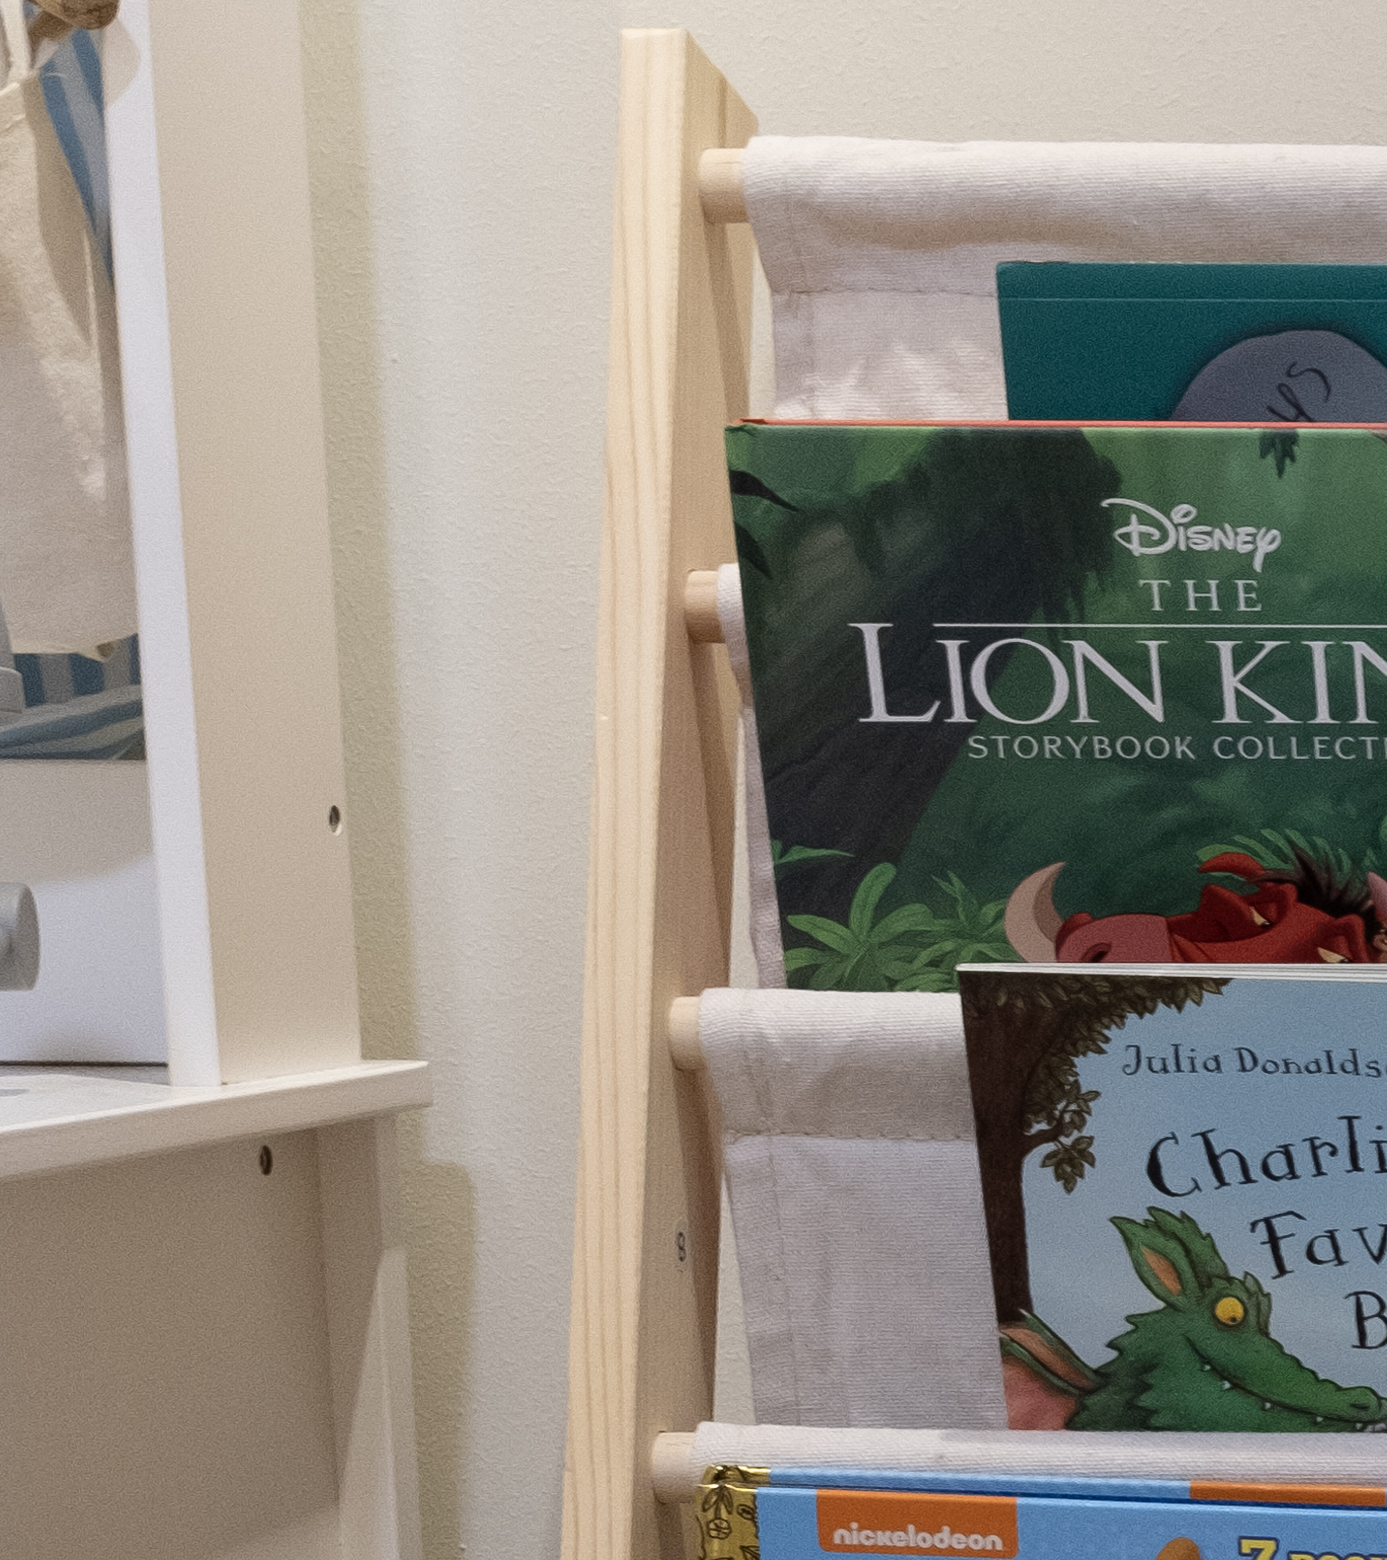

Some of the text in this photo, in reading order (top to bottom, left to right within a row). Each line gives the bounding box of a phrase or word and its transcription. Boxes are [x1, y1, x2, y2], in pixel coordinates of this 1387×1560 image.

[1139, 579, 1262, 612] THE
[849, 622, 1166, 725] LION
[968, 735, 1197, 761] STORYBOOK
[1120, 1043, 1223, 1079] Julia
[832, 1524, 1004, 1552] nickelodeon
